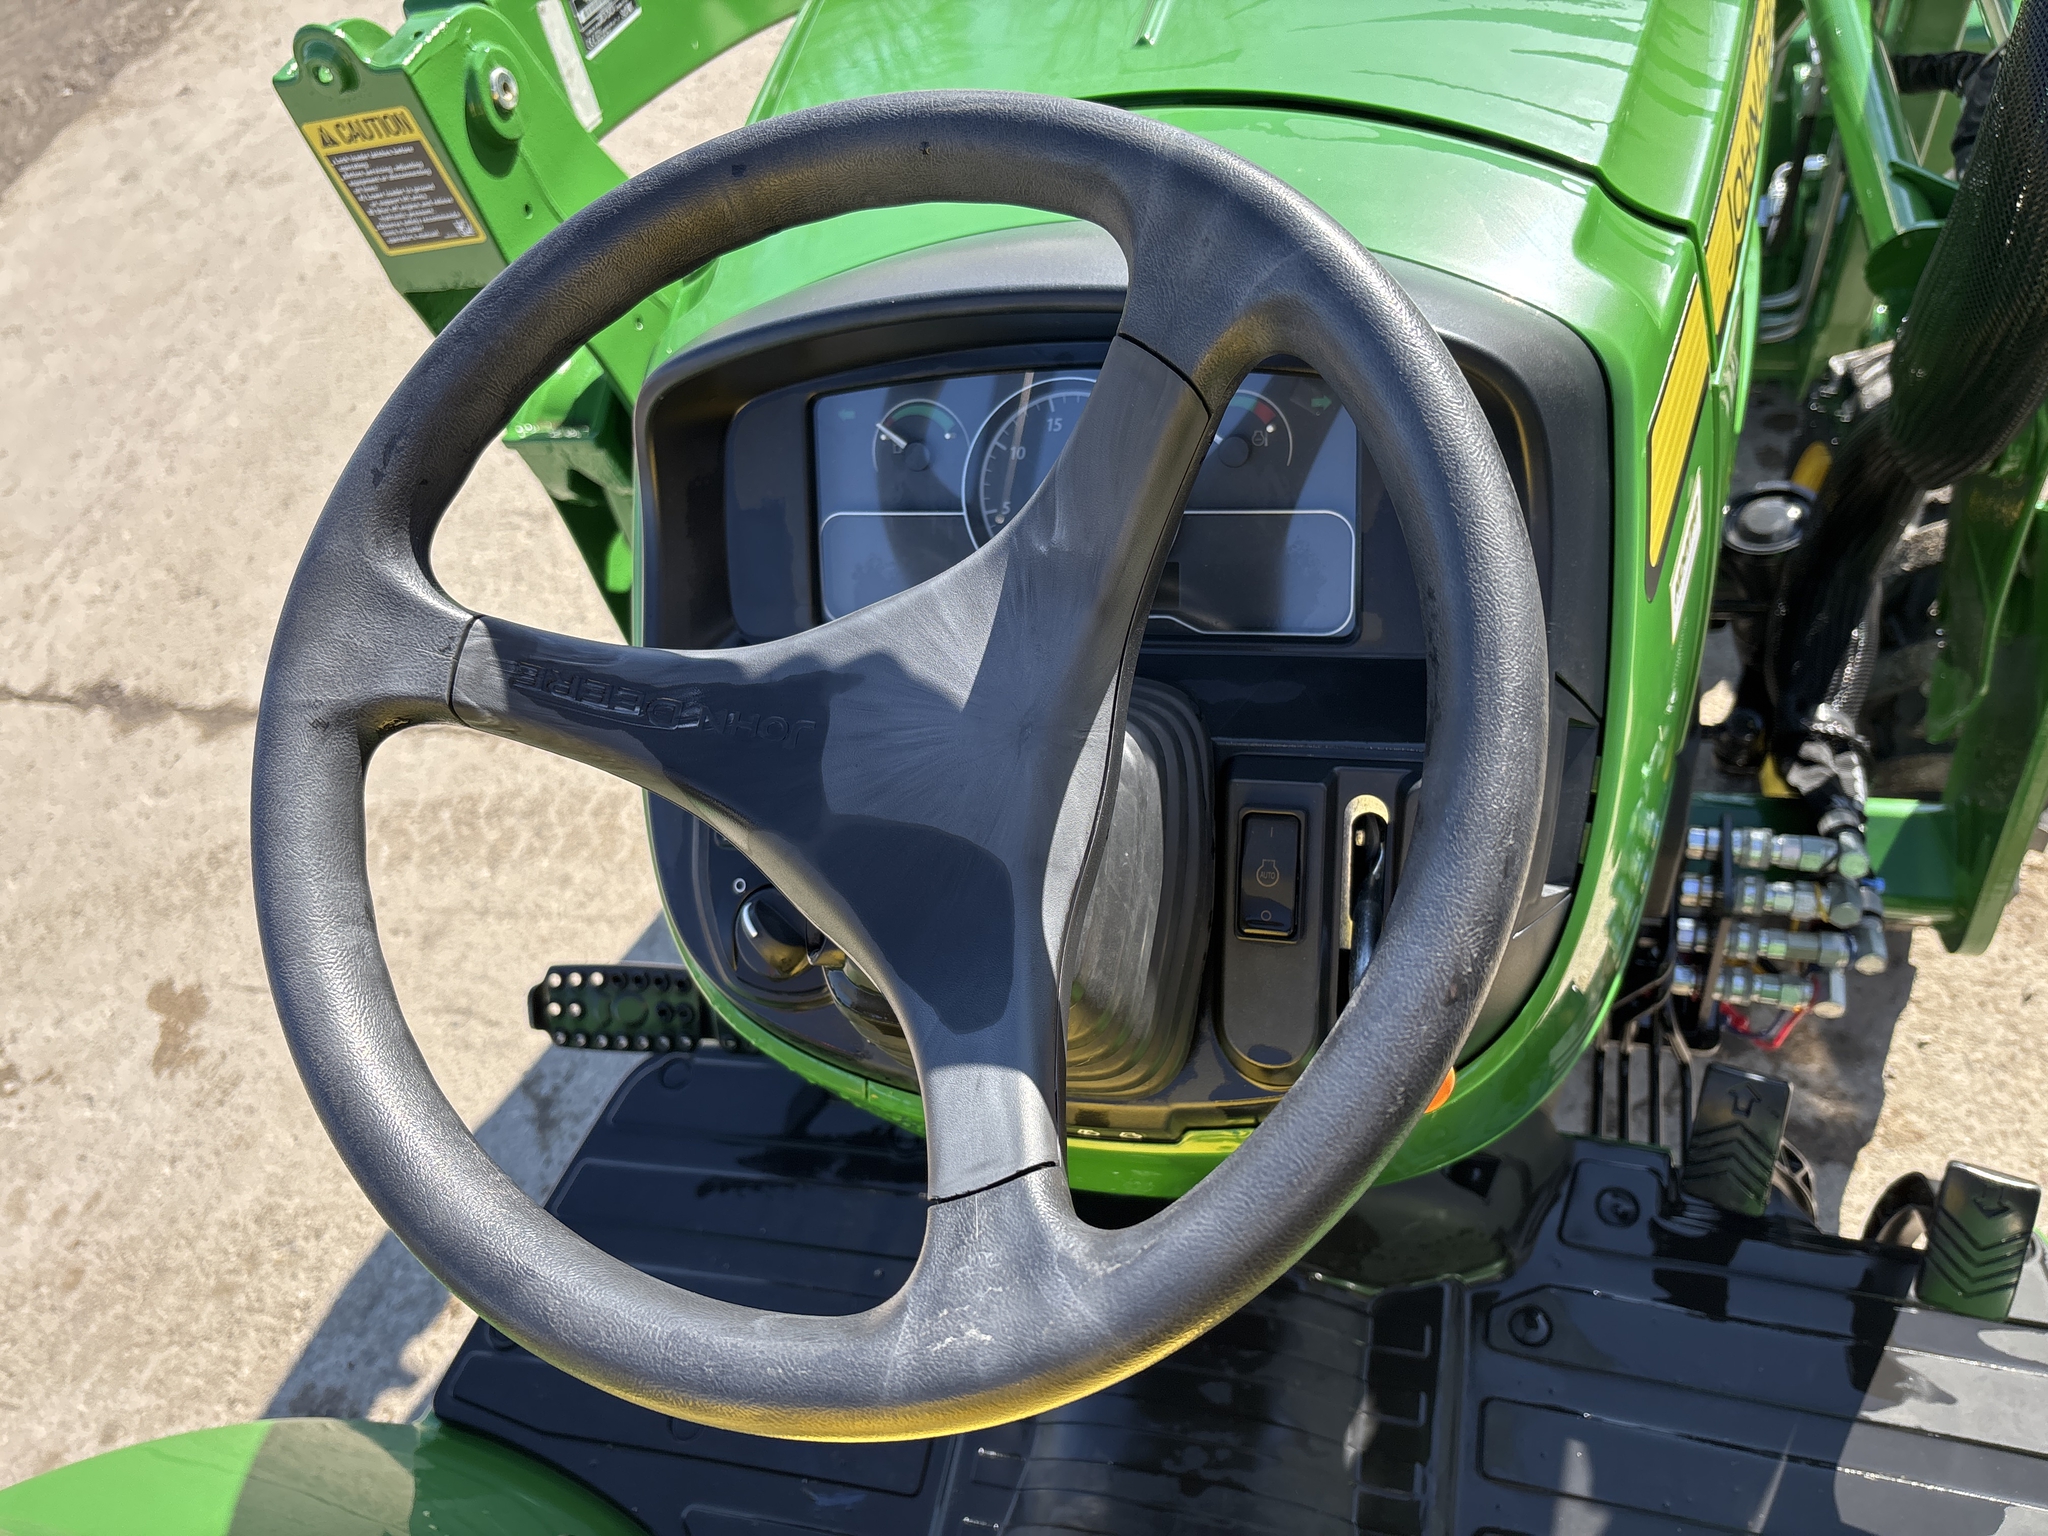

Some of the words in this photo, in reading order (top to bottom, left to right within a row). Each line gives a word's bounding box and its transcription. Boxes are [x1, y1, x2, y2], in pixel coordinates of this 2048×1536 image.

[334, 112, 414, 144] CAUTION
[1047, 417, 1063, 432] 15
[1010, 446, 1026, 460] 10
[1002, 501, 1011, 515] 5
[511, 661, 682, 730] DEERE
[700, 705, 817, 749] JOHN
[1260, 871, 1275, 880] AUTO
